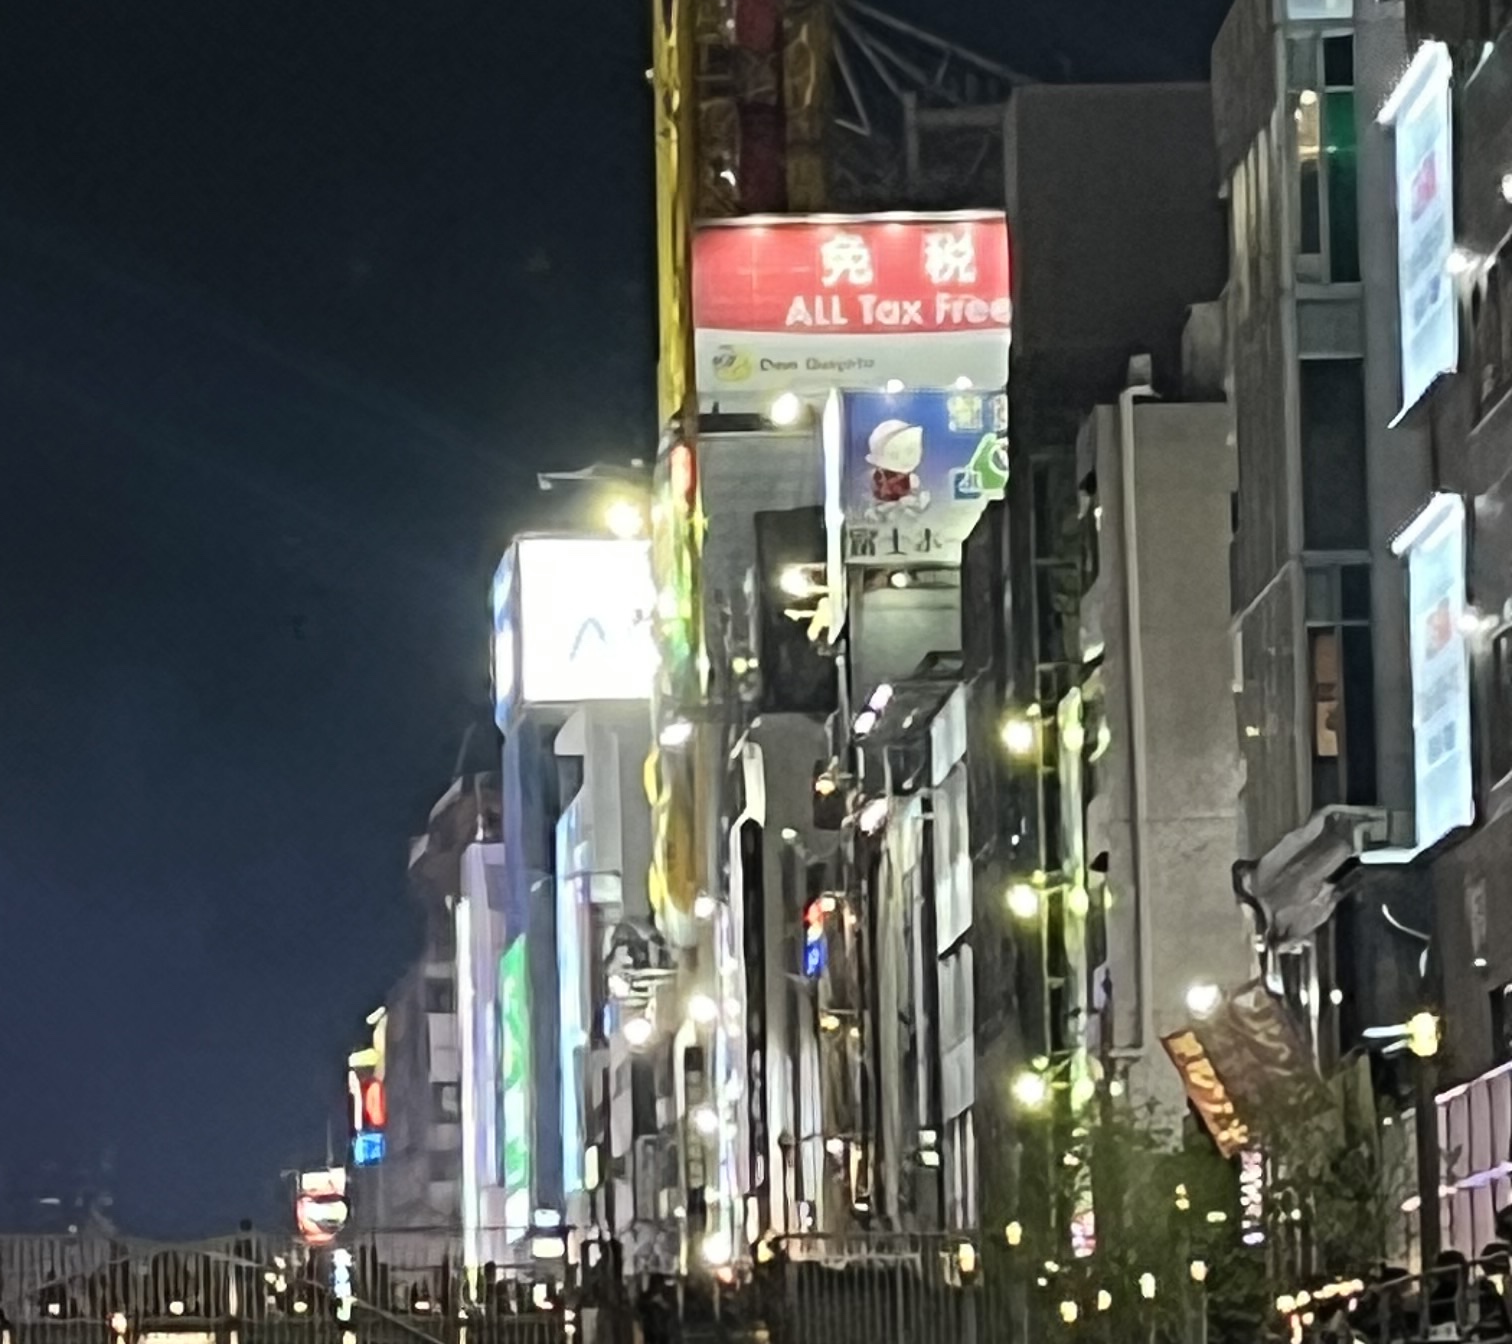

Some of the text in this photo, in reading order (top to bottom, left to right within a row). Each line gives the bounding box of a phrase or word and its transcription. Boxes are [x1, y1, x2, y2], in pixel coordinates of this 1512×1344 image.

[819, 224, 978, 287] 免税
[785, 291, 1013, 326] ALL Tax Free
